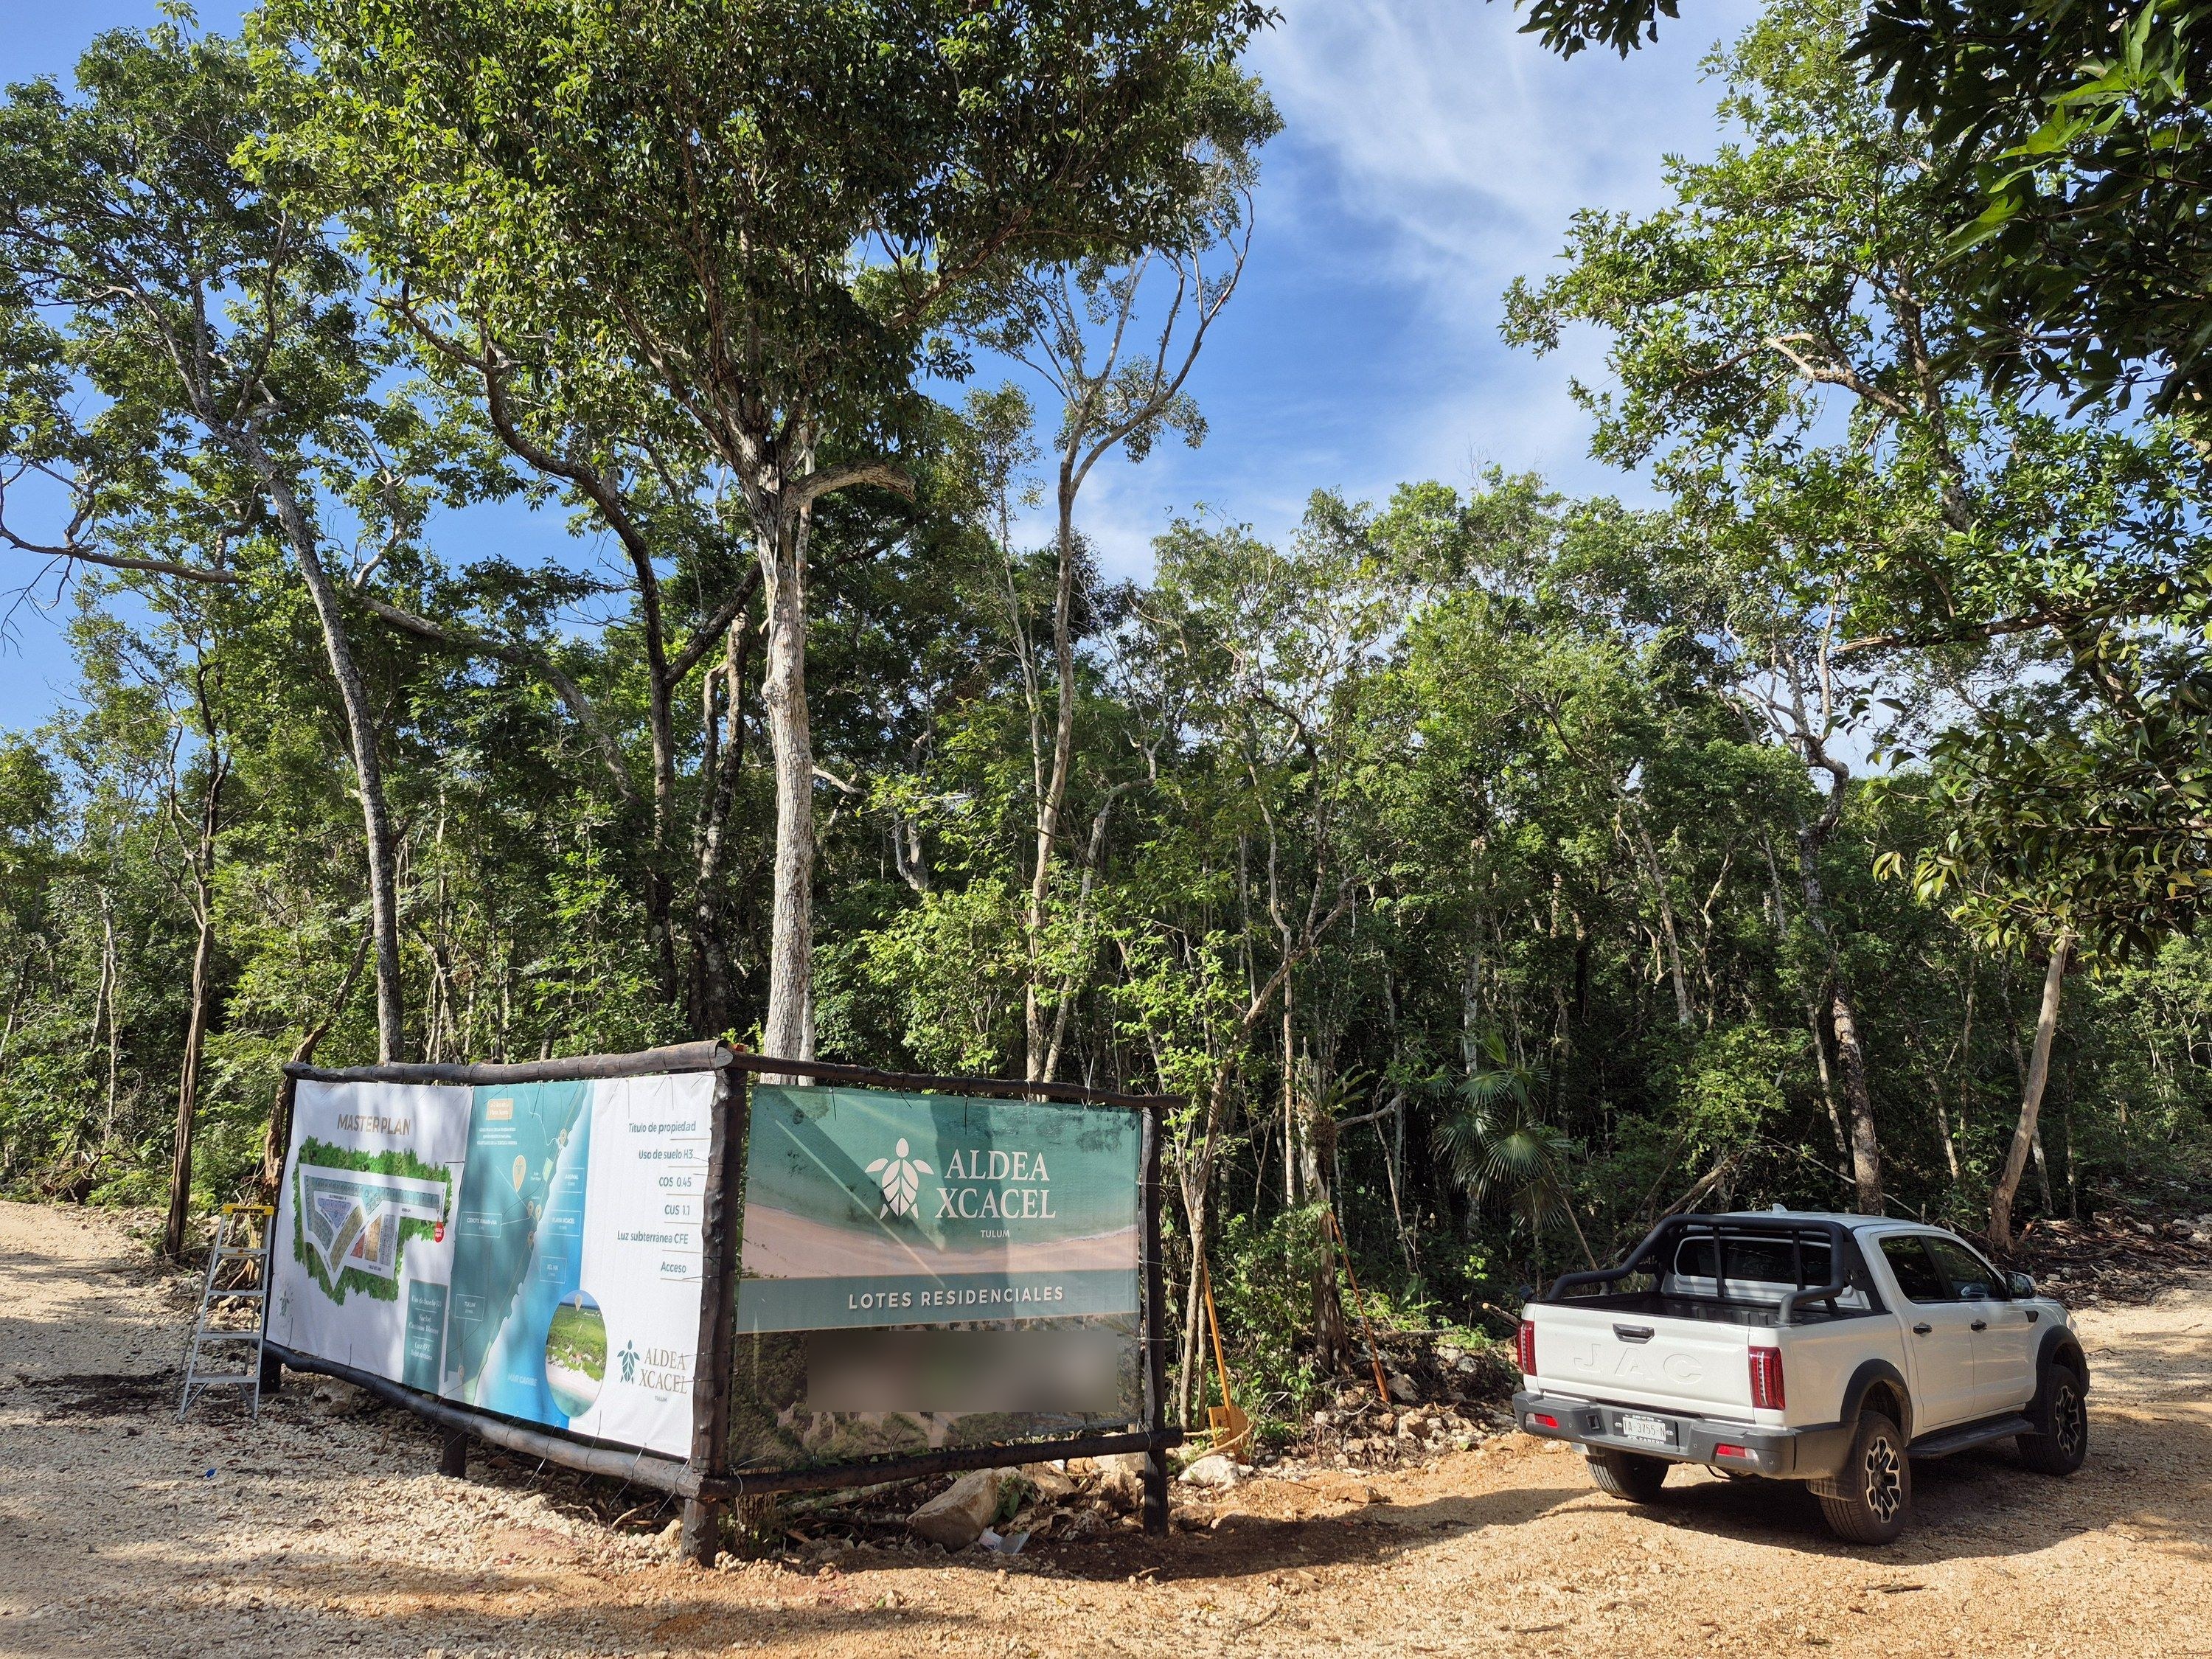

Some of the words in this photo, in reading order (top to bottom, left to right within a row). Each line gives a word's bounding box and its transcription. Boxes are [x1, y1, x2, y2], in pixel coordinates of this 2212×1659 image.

[648, 1122, 657, 1133] de
[658, 1121, 696, 1134] propiedad
[639, 1150, 651, 1159] Uso
[653, 1149, 662, 1159] de
[664, 1149, 682, 1159] suelo
[684, 1149, 694, 1159] H3
[944, 1149, 1050, 1181] ALDEA
[658, 1177, 673, 1187] COS
[676, 1177, 692, 1187] 0.45
[664, 1204, 679, 1215] CUS
[682, 1205, 690, 1216] 1.1
[935, 1187, 1056, 1219] XCACEL
[617, 1230, 629, 1241] Luz
[630, 1231, 672, 1243] subterránea
[674, 1233, 689, 1244] CFE
[980, 1230, 1010, 1238] TULUM
[661, 1261, 686, 1273] Acceso
[849, 1292, 912, 1310] LOTES
[921, 1286, 1064, 1306] RESIDENCIALES
[644, 1347, 686, 1370] ALDEA
[1574, 1343, 1703, 1385] JAC
[639, 1368, 687, 1394] XCACEL
